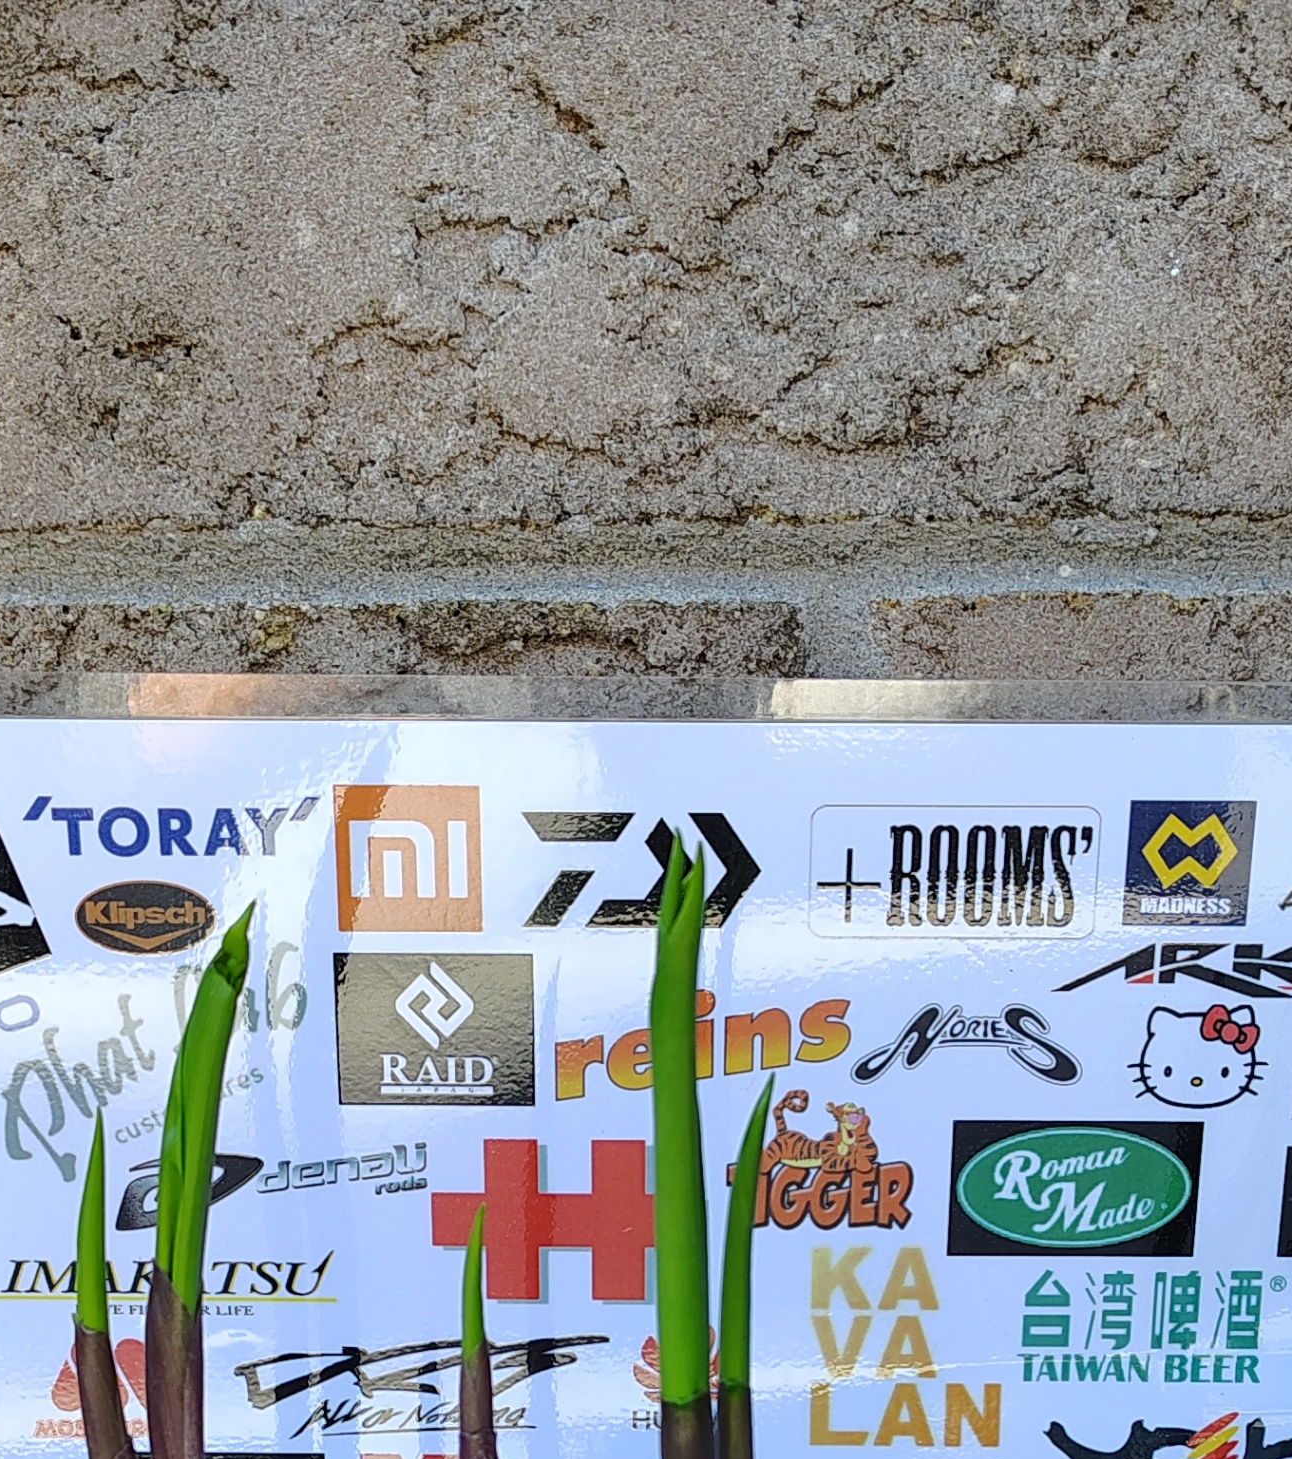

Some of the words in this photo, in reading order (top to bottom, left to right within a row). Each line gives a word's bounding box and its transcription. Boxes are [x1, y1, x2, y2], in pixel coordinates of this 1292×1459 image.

[84, 901, 206, 929] Klipsch
[1140, 897, 1231, 915] MADNESS
[1, 993, 156, 1182] Phat
[380, 1054, 495, 1085] RAID
[257, 1142, 427, 1193] denali
[375, 1174, 428, 1195] rods
[993, 1146, 1130, 1212] Roman
[1033, 1181, 1156, 1234] Made
[810, 1247, 939, 1311] KA
[216, 1305, 255, 1317] LIFE
[1021, 1269, 1264, 1351] 台湾啤酒
[811, 1315, 938, 1379] VA
[1017, 1353, 1151, 1383] TAIWAN
[1163, 1354, 1261, 1384] BEER
[809, 1382, 1002, 1448] LAN
